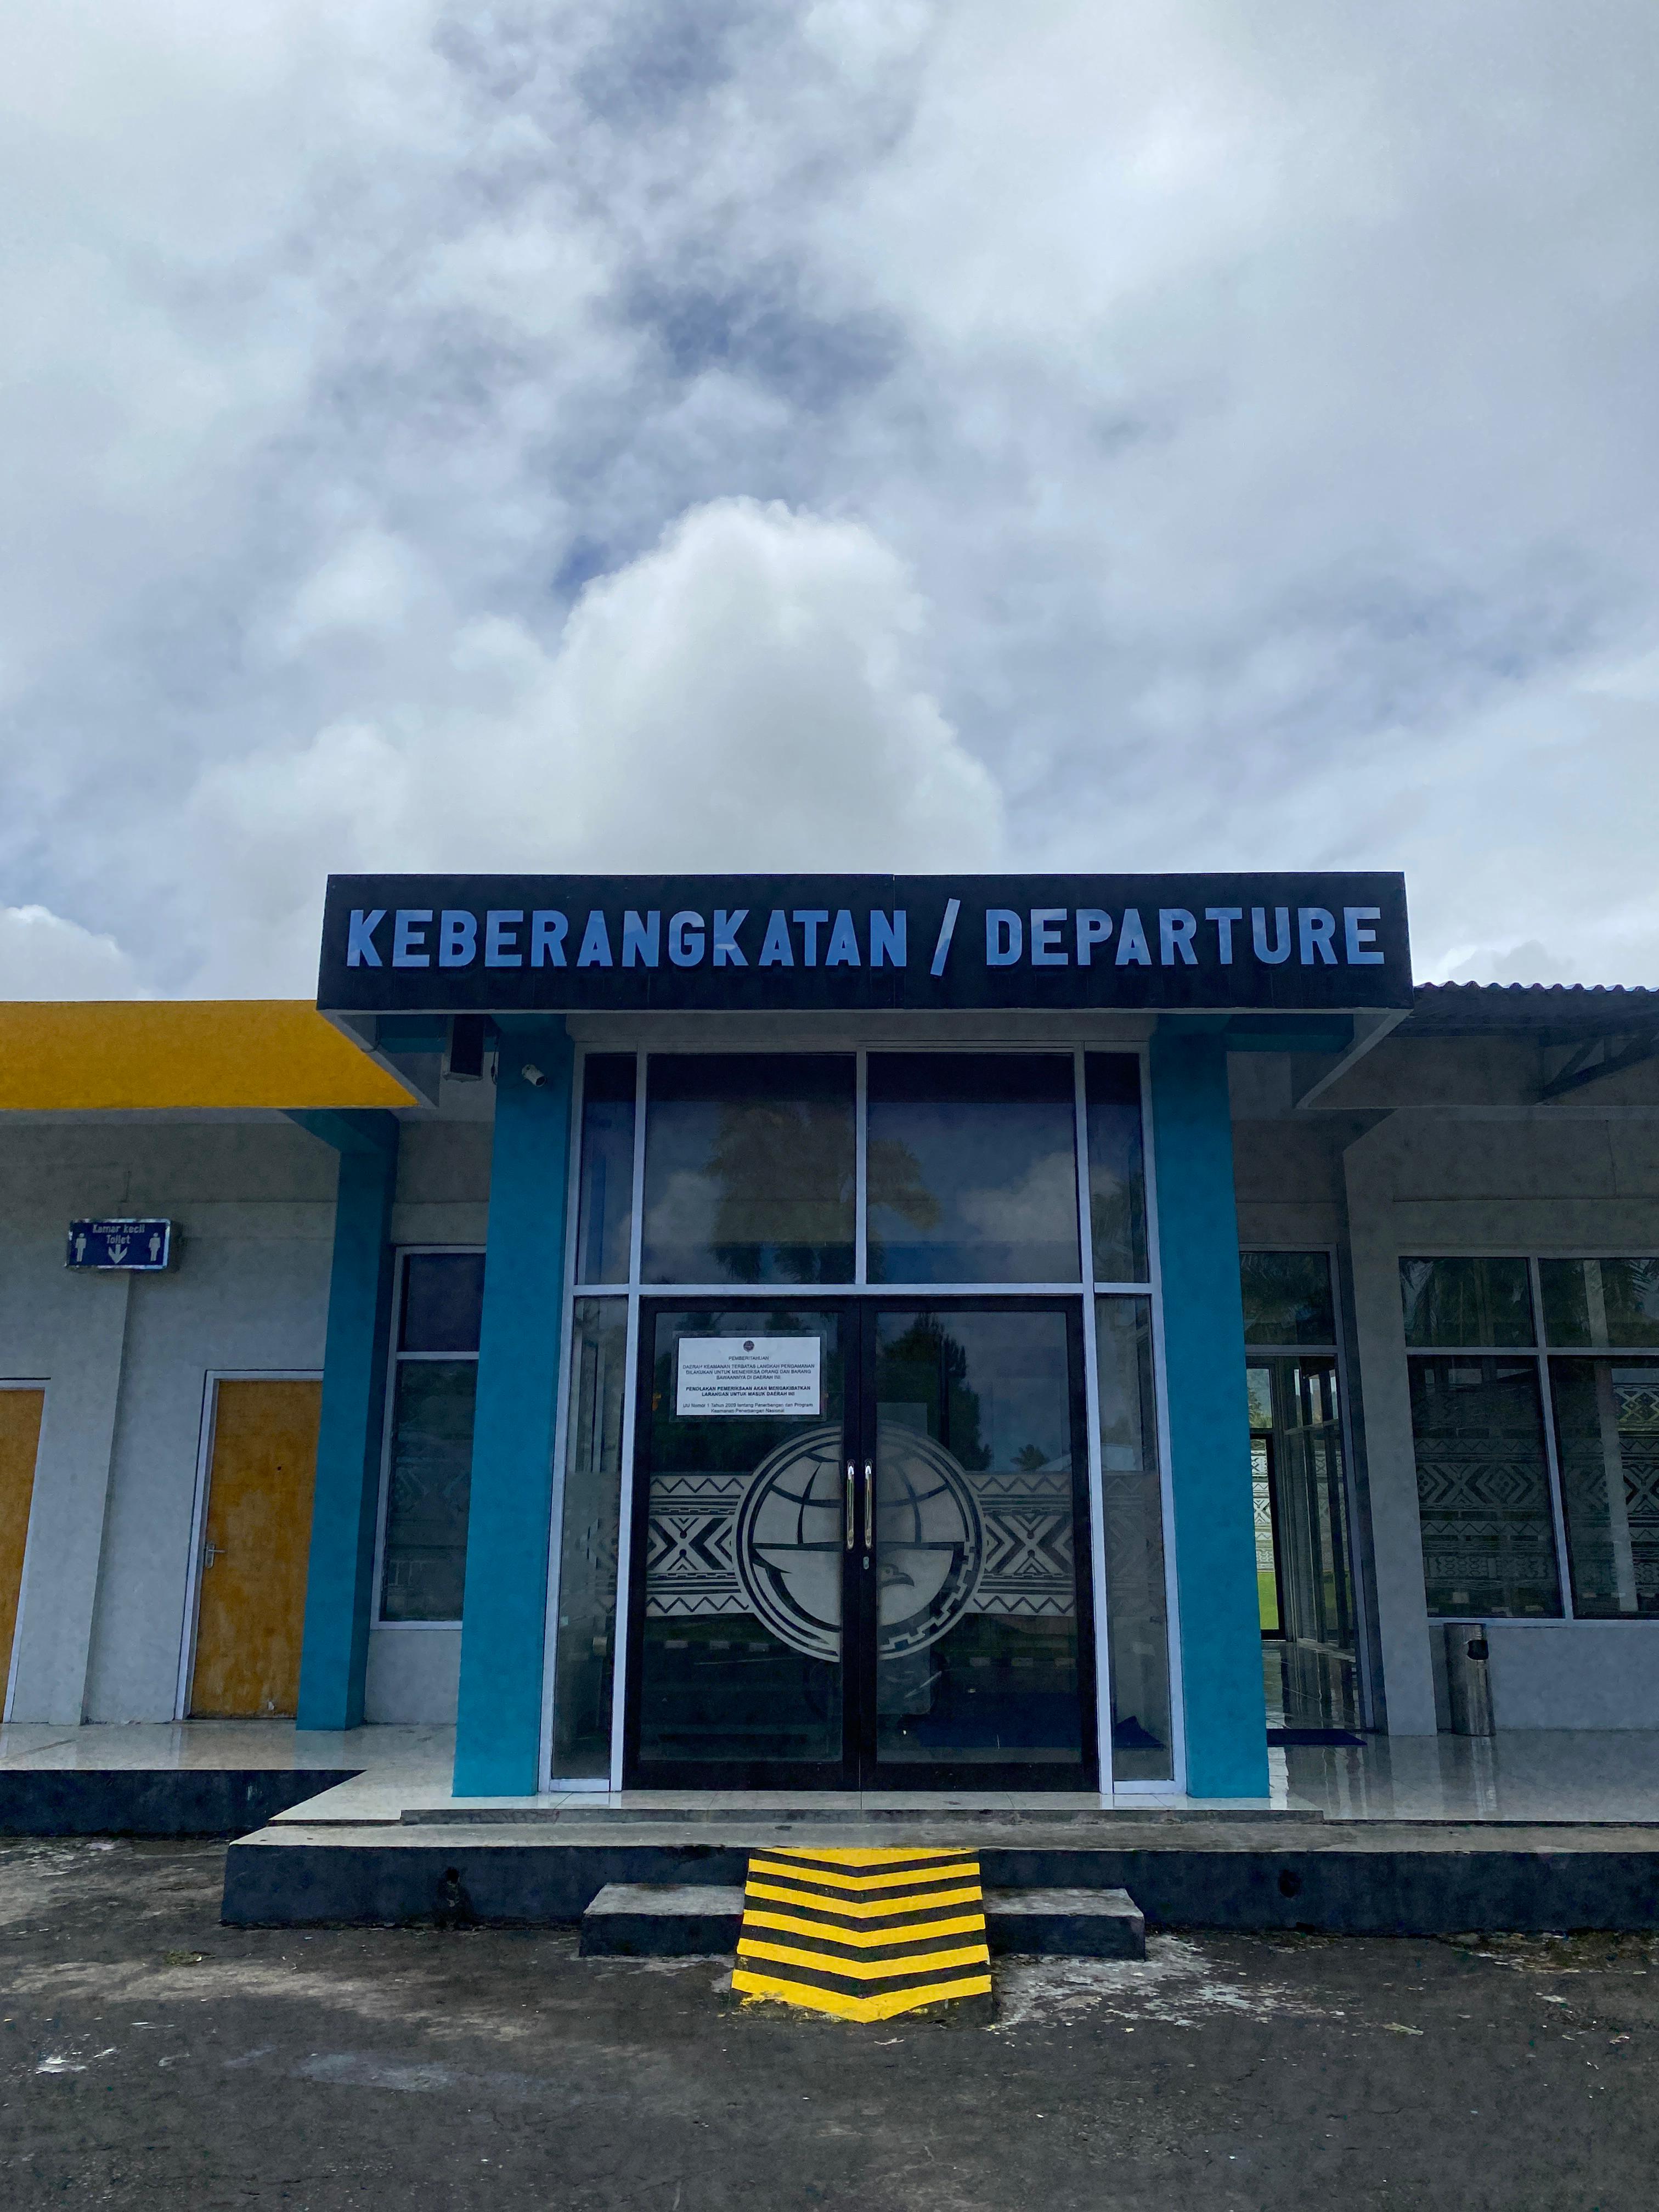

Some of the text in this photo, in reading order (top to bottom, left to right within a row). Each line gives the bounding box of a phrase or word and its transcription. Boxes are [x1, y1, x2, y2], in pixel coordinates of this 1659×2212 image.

[347, 898, 1385, 977] KEBERANGKATAN / DEPARTURE
[92, 1224, 121, 1233] Kamar
[106, 1234, 131, 1244] Toilet
